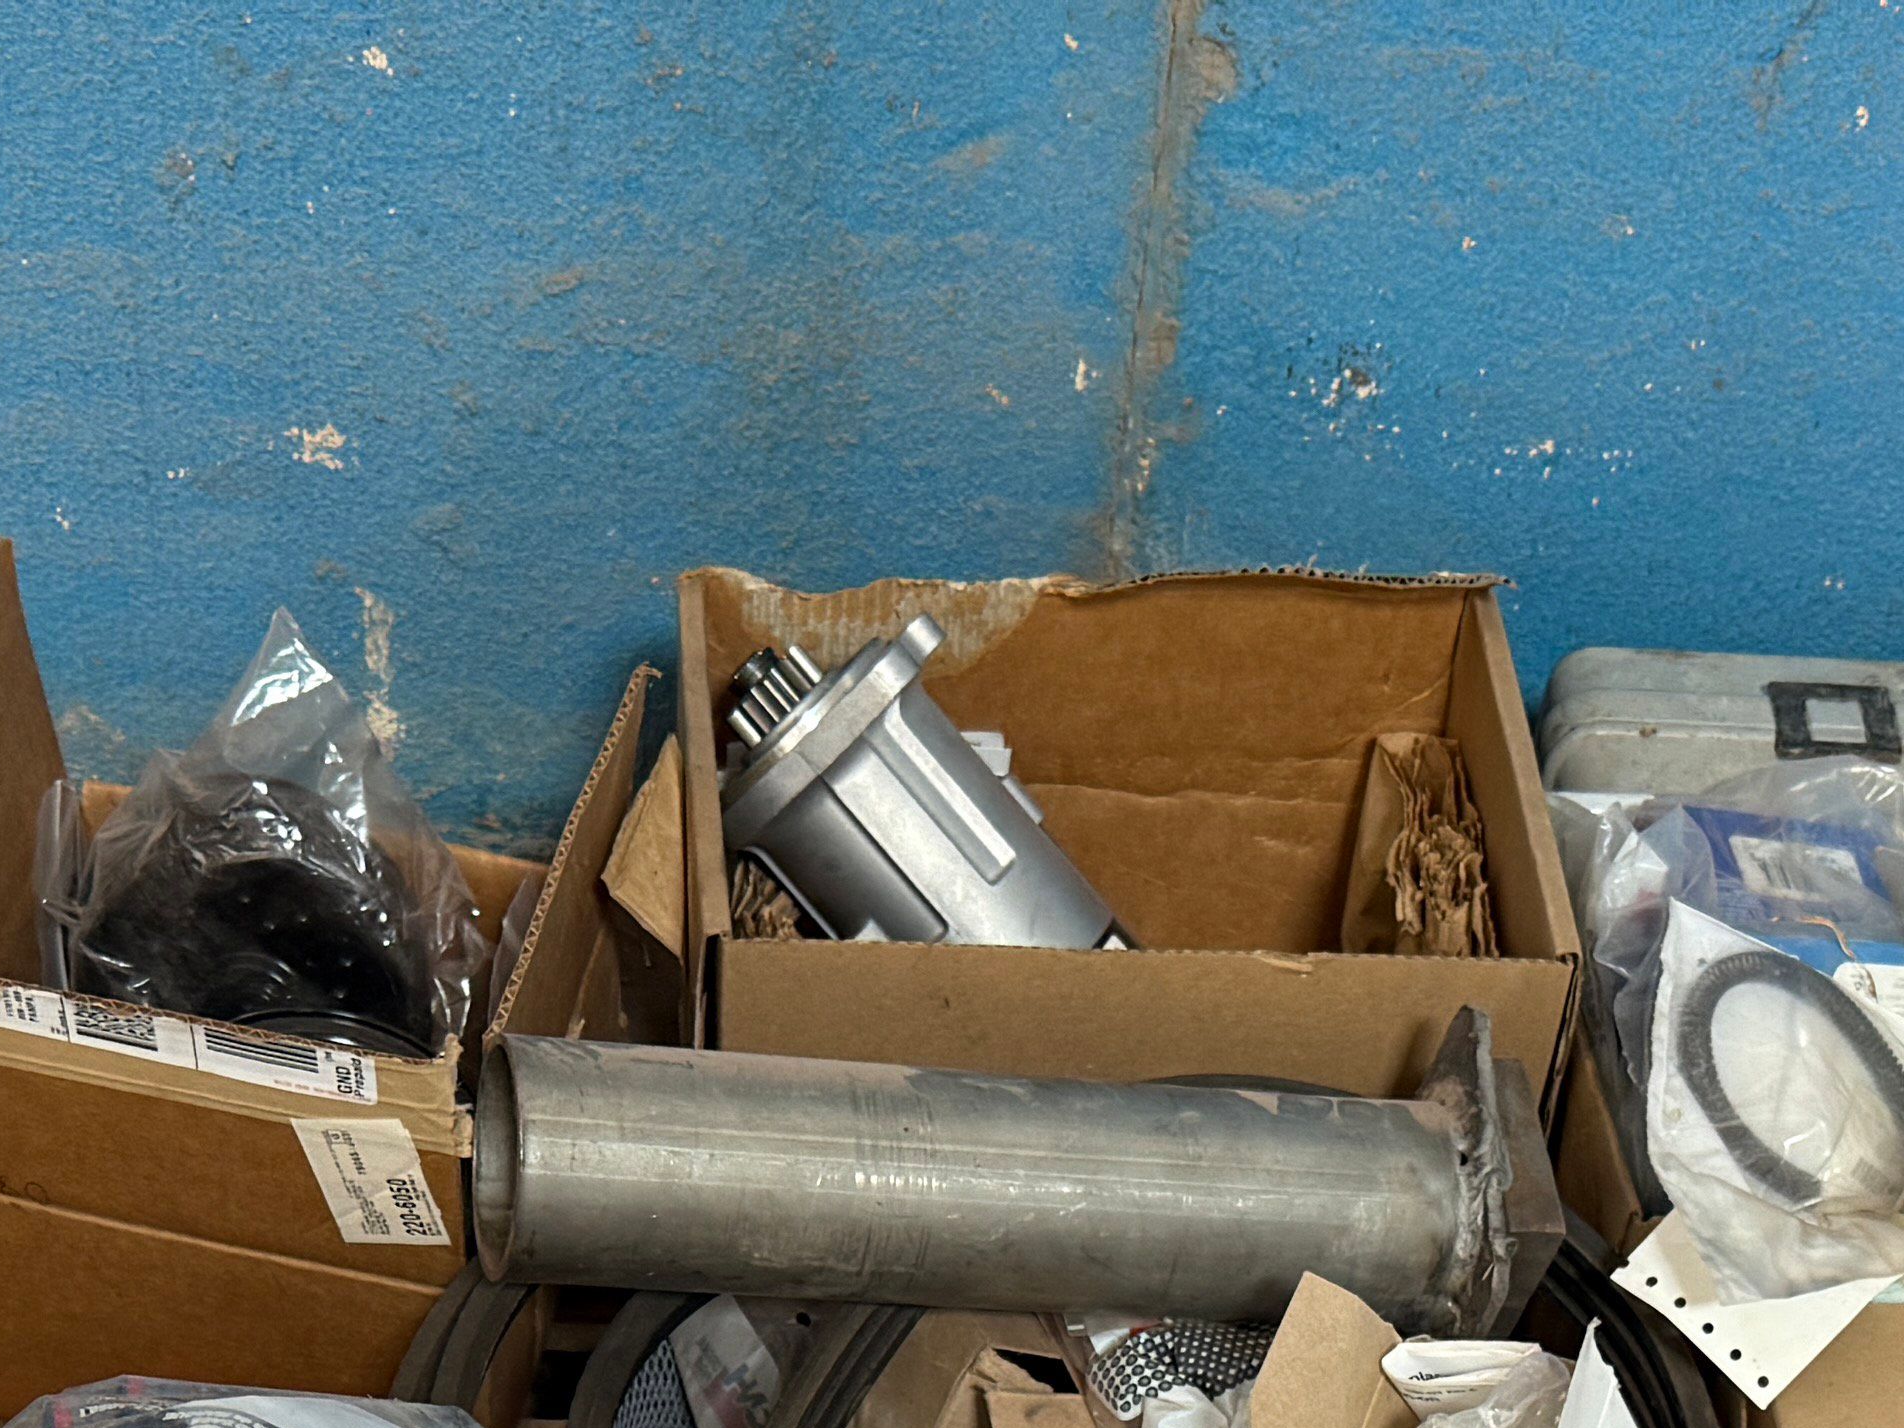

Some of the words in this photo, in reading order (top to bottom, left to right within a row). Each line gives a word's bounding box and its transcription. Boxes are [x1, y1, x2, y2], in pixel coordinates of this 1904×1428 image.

[335, 1065, 353, 1094] GND
[351, 1057, 366, 1099] Prepaid
[386, 1177, 428, 1237] 220-6050
